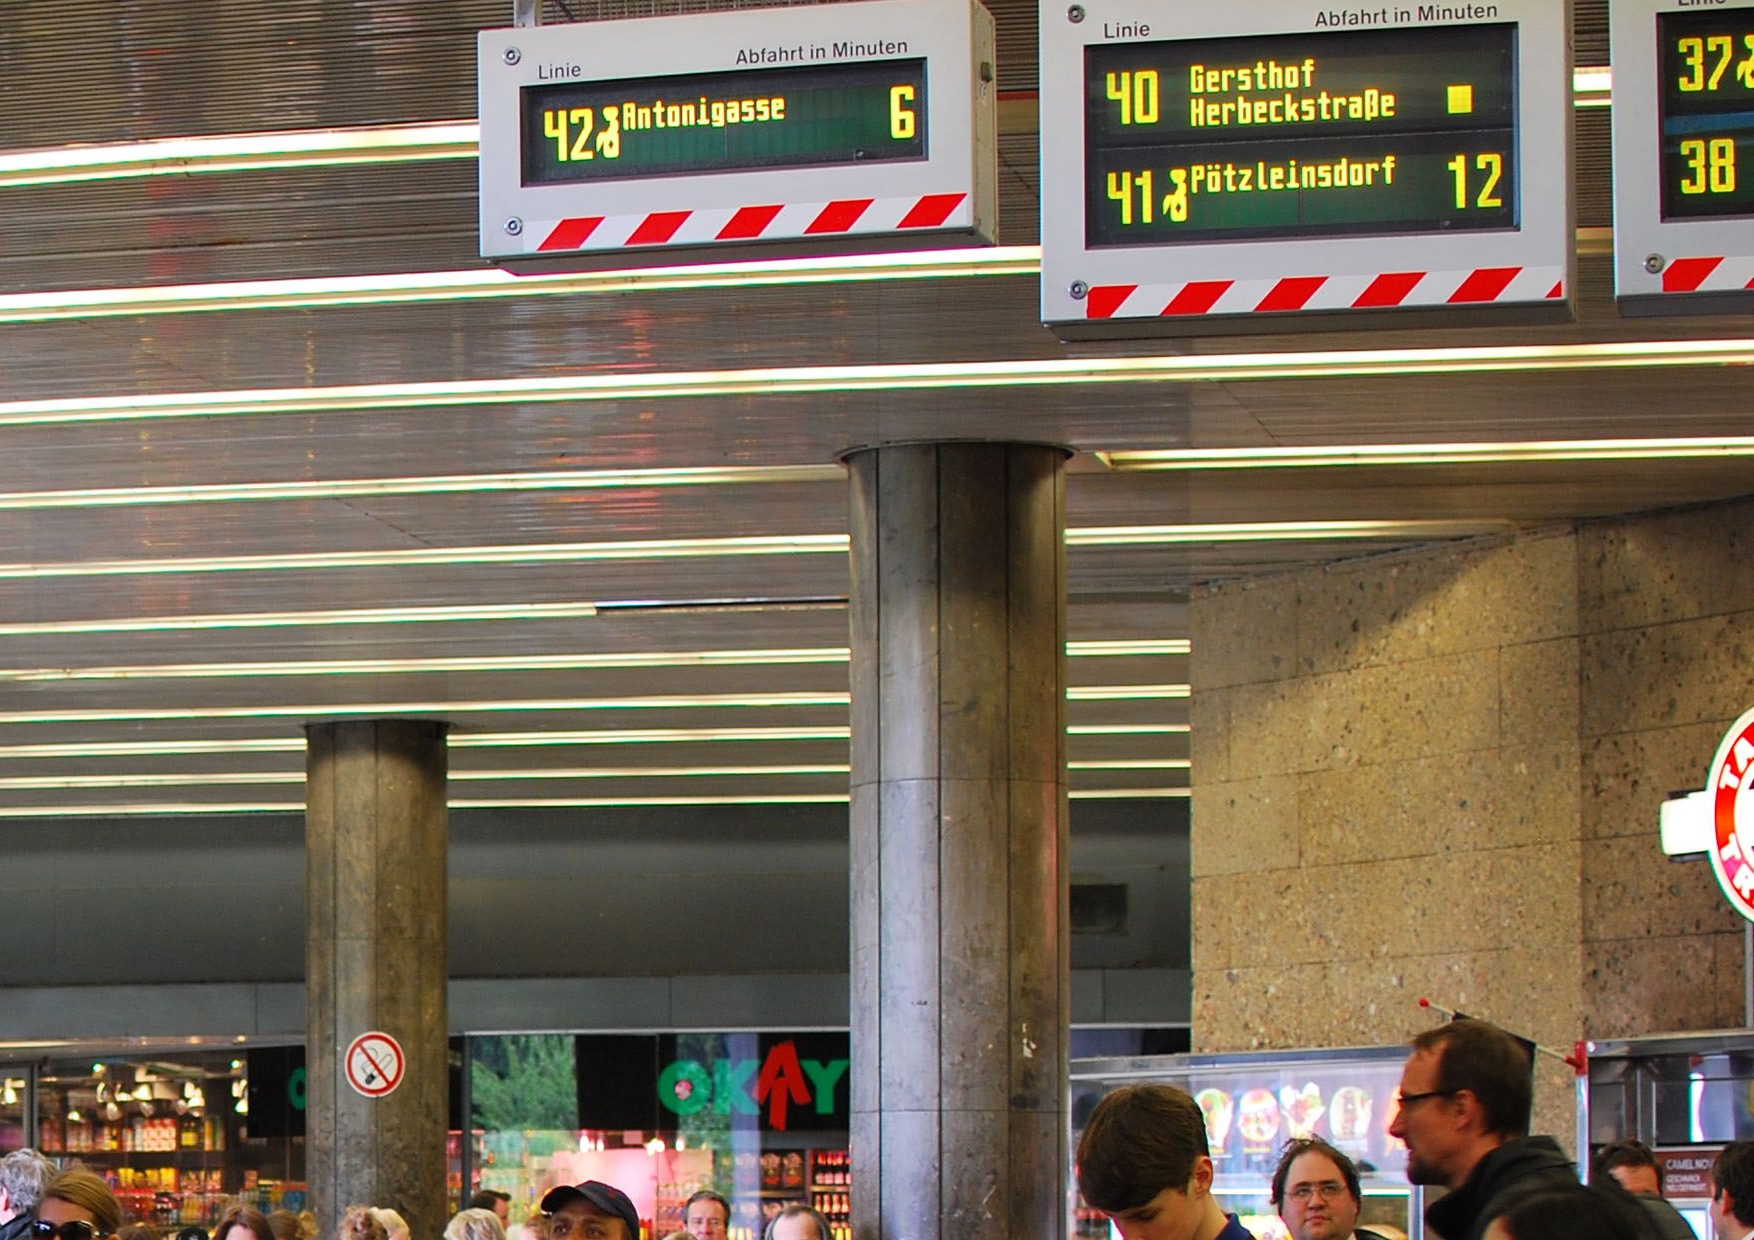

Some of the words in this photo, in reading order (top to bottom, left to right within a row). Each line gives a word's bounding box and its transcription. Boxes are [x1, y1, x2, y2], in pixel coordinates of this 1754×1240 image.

[1103, 22, 1151, 39] Linie
[1315, 8, 1388, 28] Abfahrt
[1393, 8, 1411, 23] in
[1417, 3, 1498, 21] Minuten
[538, 63, 582, 81] Linie
[735, 45, 806, 65] Abfahrt
[810, 44, 827, 60] in
[832, 39, 909, 59] Minuten
[1189, 58, 1316, 93] Gersthof
[1677, 34, 1733, 92] 37
[543, 107, 594, 163] 42
[622, 96, 786, 132] Antonigasse
[888, 83, 917, 140] 6
[1105, 69, 1159, 126] 40
[1189, 87, 1396, 128] Herbeckstraße
[1107, 169, 1154, 225] 41
[1190, 154, 1397, 194] Pötzleinsdorf
[1447, 153, 1503, 210] 12
[1679, 137, 1736, 194] 38
[656, 1038, 850, 1132] OKAY
